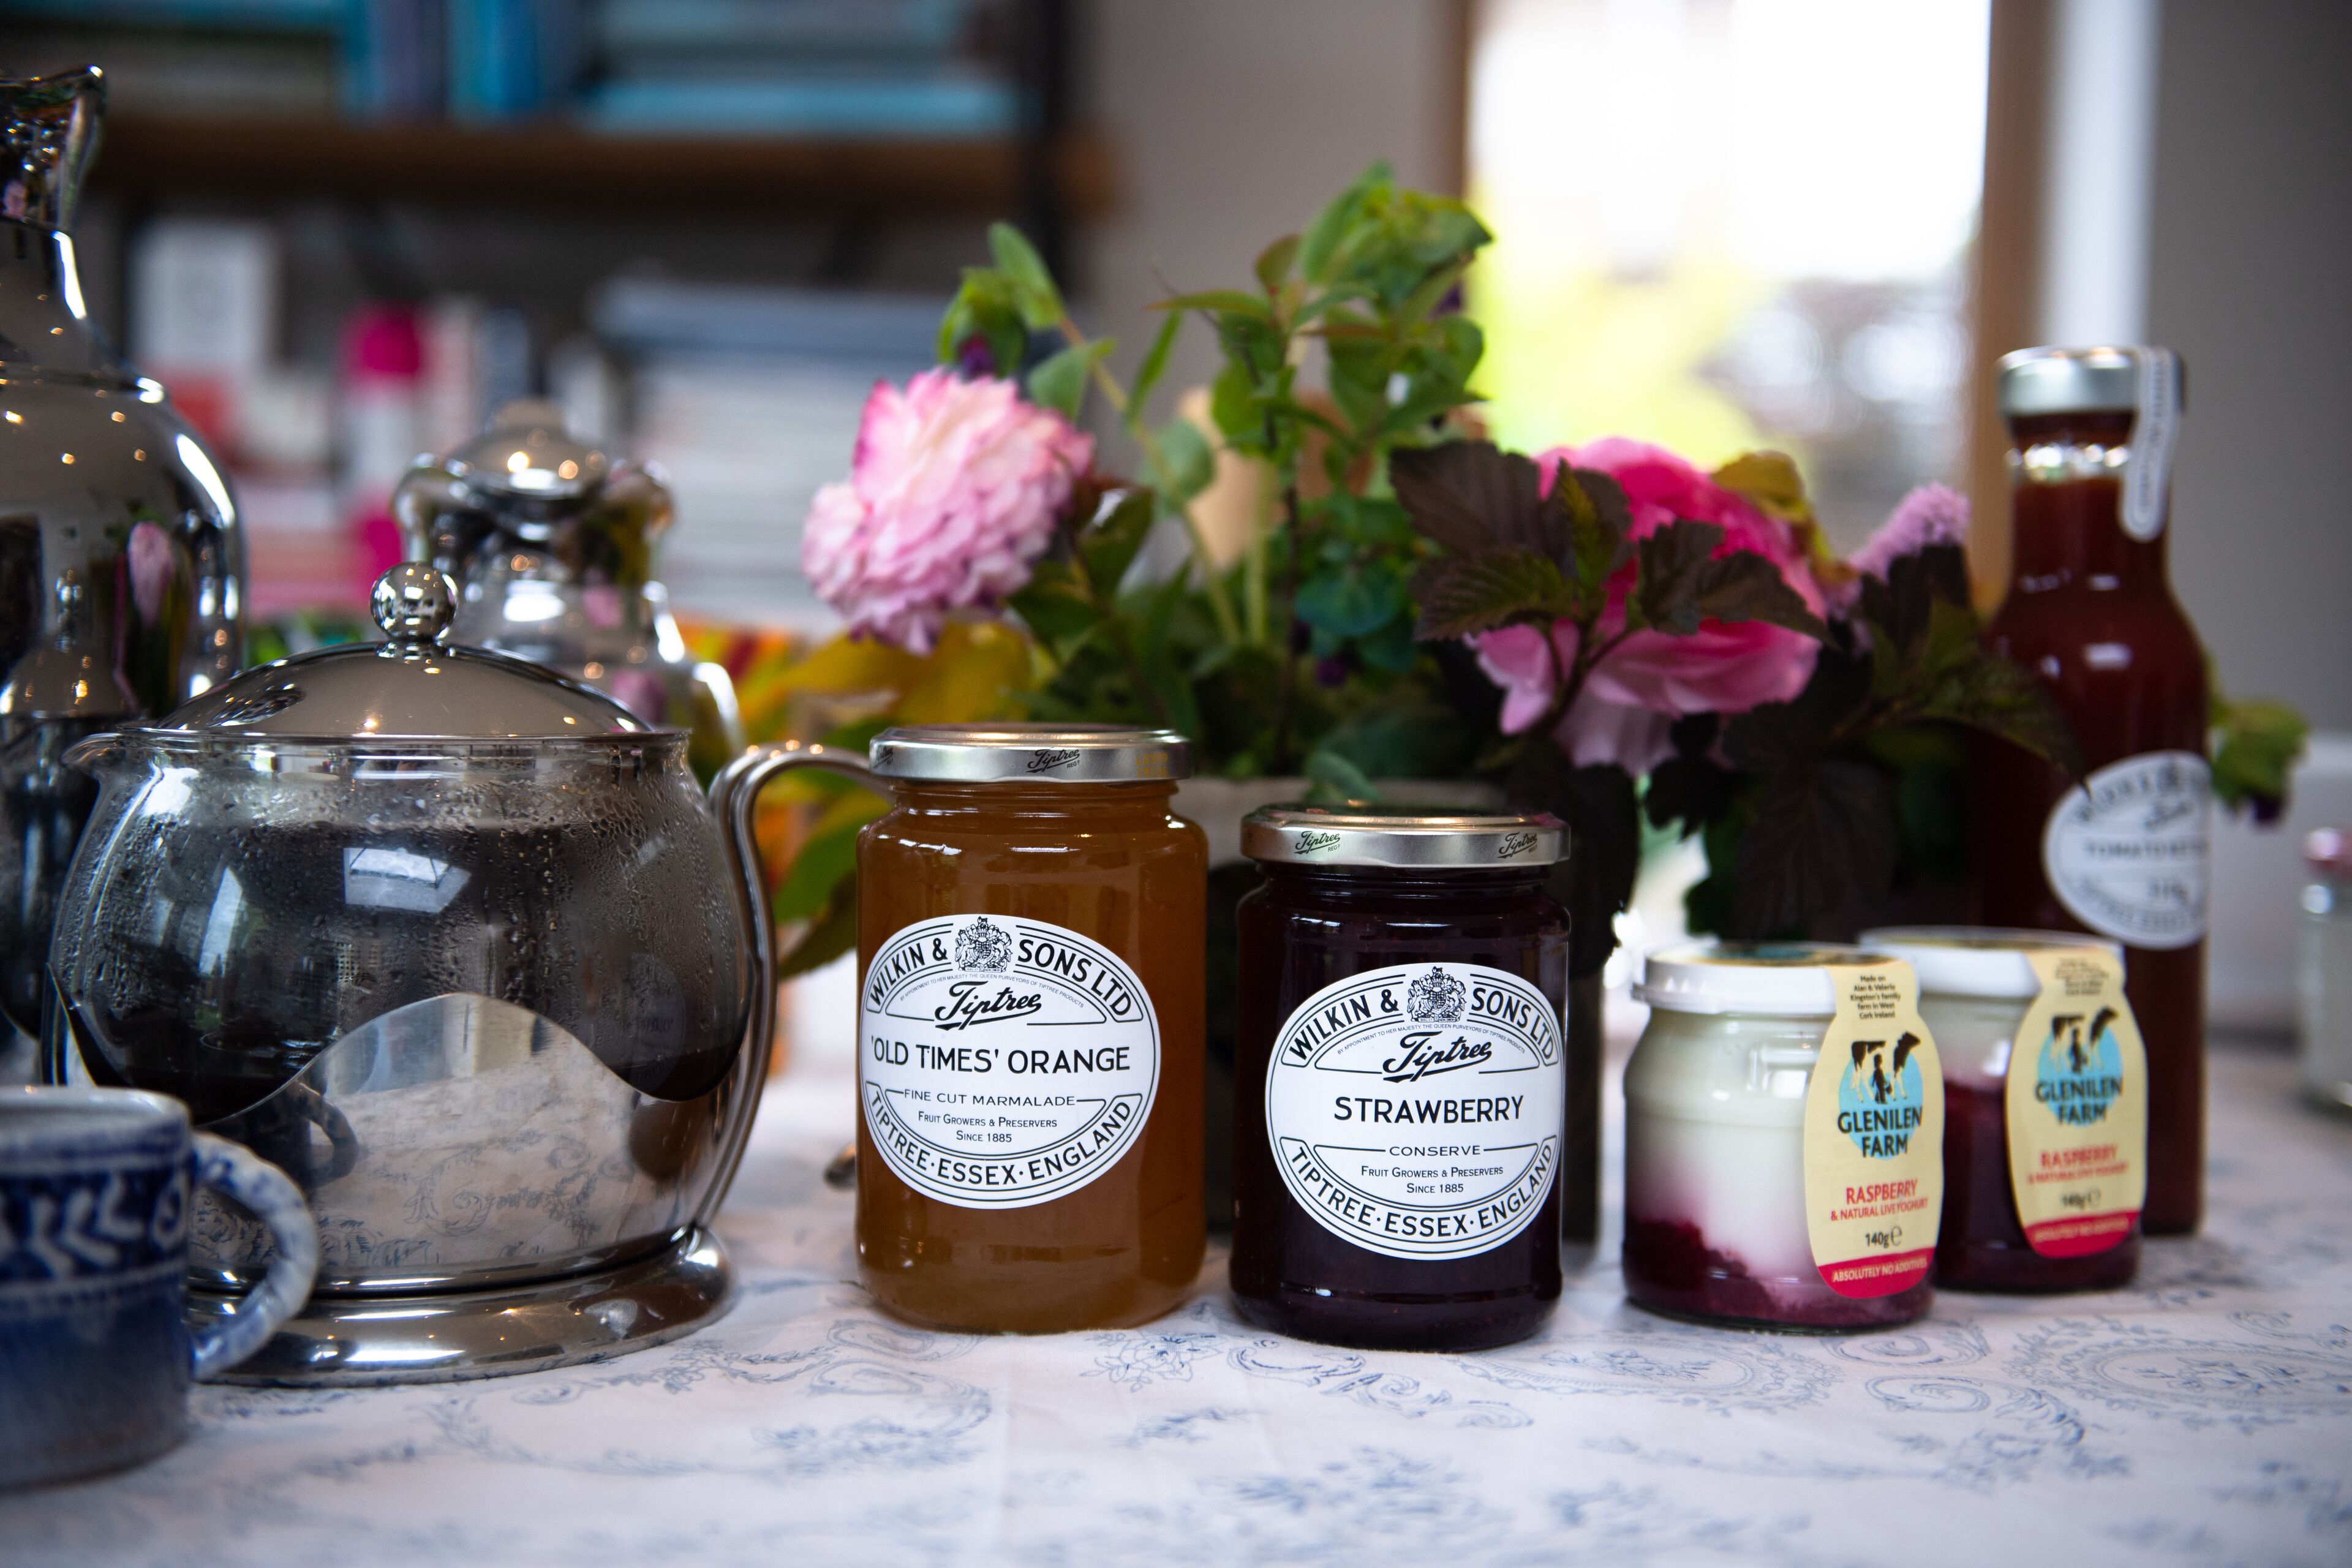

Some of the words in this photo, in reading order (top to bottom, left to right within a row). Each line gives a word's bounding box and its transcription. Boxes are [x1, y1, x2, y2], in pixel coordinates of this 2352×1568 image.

[1026, 749, 1080, 773] Tiptree
[1294, 831, 1340, 854] Tiptree
[870, 943, 925, 1006] WILKIN
[932, 938, 948, 961] &
[1017, 939, 1092, 982] SONS
[1091, 970, 1131, 1016] LTD
[905, 981, 930, 997] APPOINTMENT
[998, 974, 1030, 984] PURVEYORS
[1039, 983, 1059, 993] TIPTREE
[1060, 991, 1084, 1008] PRODUCTS
[935, 981, 1042, 1031] Tiptree
[1289, 994, 1371, 1060] WILKIN
[1380, 989, 1400, 1013] &
[1471, 987, 1531, 1029] SONS
[1530, 1014, 1554, 1060] LTD
[1344, 1033, 1377, 1050] APPOINTMENT
[1453, 1024, 1482, 1033] PURVEYORS
[1490, 1031, 1507, 1041] TIPTREE
[1507, 1038, 1525, 1054] PRODUCTS
[916, 1044, 999, 1073] TIMES'
[1008, 1046, 1130, 1074] ORANGE
[1382, 1031, 1492, 1083] Tiptree
[905, 1089, 931, 1101] FINE
[937, 1093, 967, 1104] CUT
[973, 1096, 1075, 1106] MARMALADE
[2035, 1077, 2124, 1103] GLENILEN
[1334, 1095, 1524, 1124] STRAWBERRY
[1838, 1106, 1923, 1134] GLENILEN
[2058, 1103, 2107, 1125] FARM
[872, 1091, 930, 1171] TIPTREE
[937, 1158, 1017, 1186] ESSEX
[1027, 1102, 1130, 1181] ENGLAND
[987, 1133, 1012, 1143] 1885
[1389, 1145, 1481, 1156] CONSERVE
[1861, 1134, 1909, 1158] FARM
[2041, 1145, 2117, 1167] RASPBERRY
[1292, 1146, 1376, 1227] TIPTREE
[1384, 1212, 1469, 1237] ESSEX
[1477, 1145, 1551, 1230] ENGLAND
[1439, 1183, 1464, 1193] 1885
[1845, 1178, 1918, 1205] RASPBERRY
[1830, 1210, 1838, 1221] &
[1840, 1207, 1879, 1220] NATURAL
[1880, 1204, 1896, 1216] LIVE
[1896, 1197, 1928, 1213] YOGHURT
[1833, 1265, 1881, 1283] ABSOLUTELY
[1882, 1263, 1894, 1275] NO
[1894, 1257, 1928, 1272] ADDITIVES
